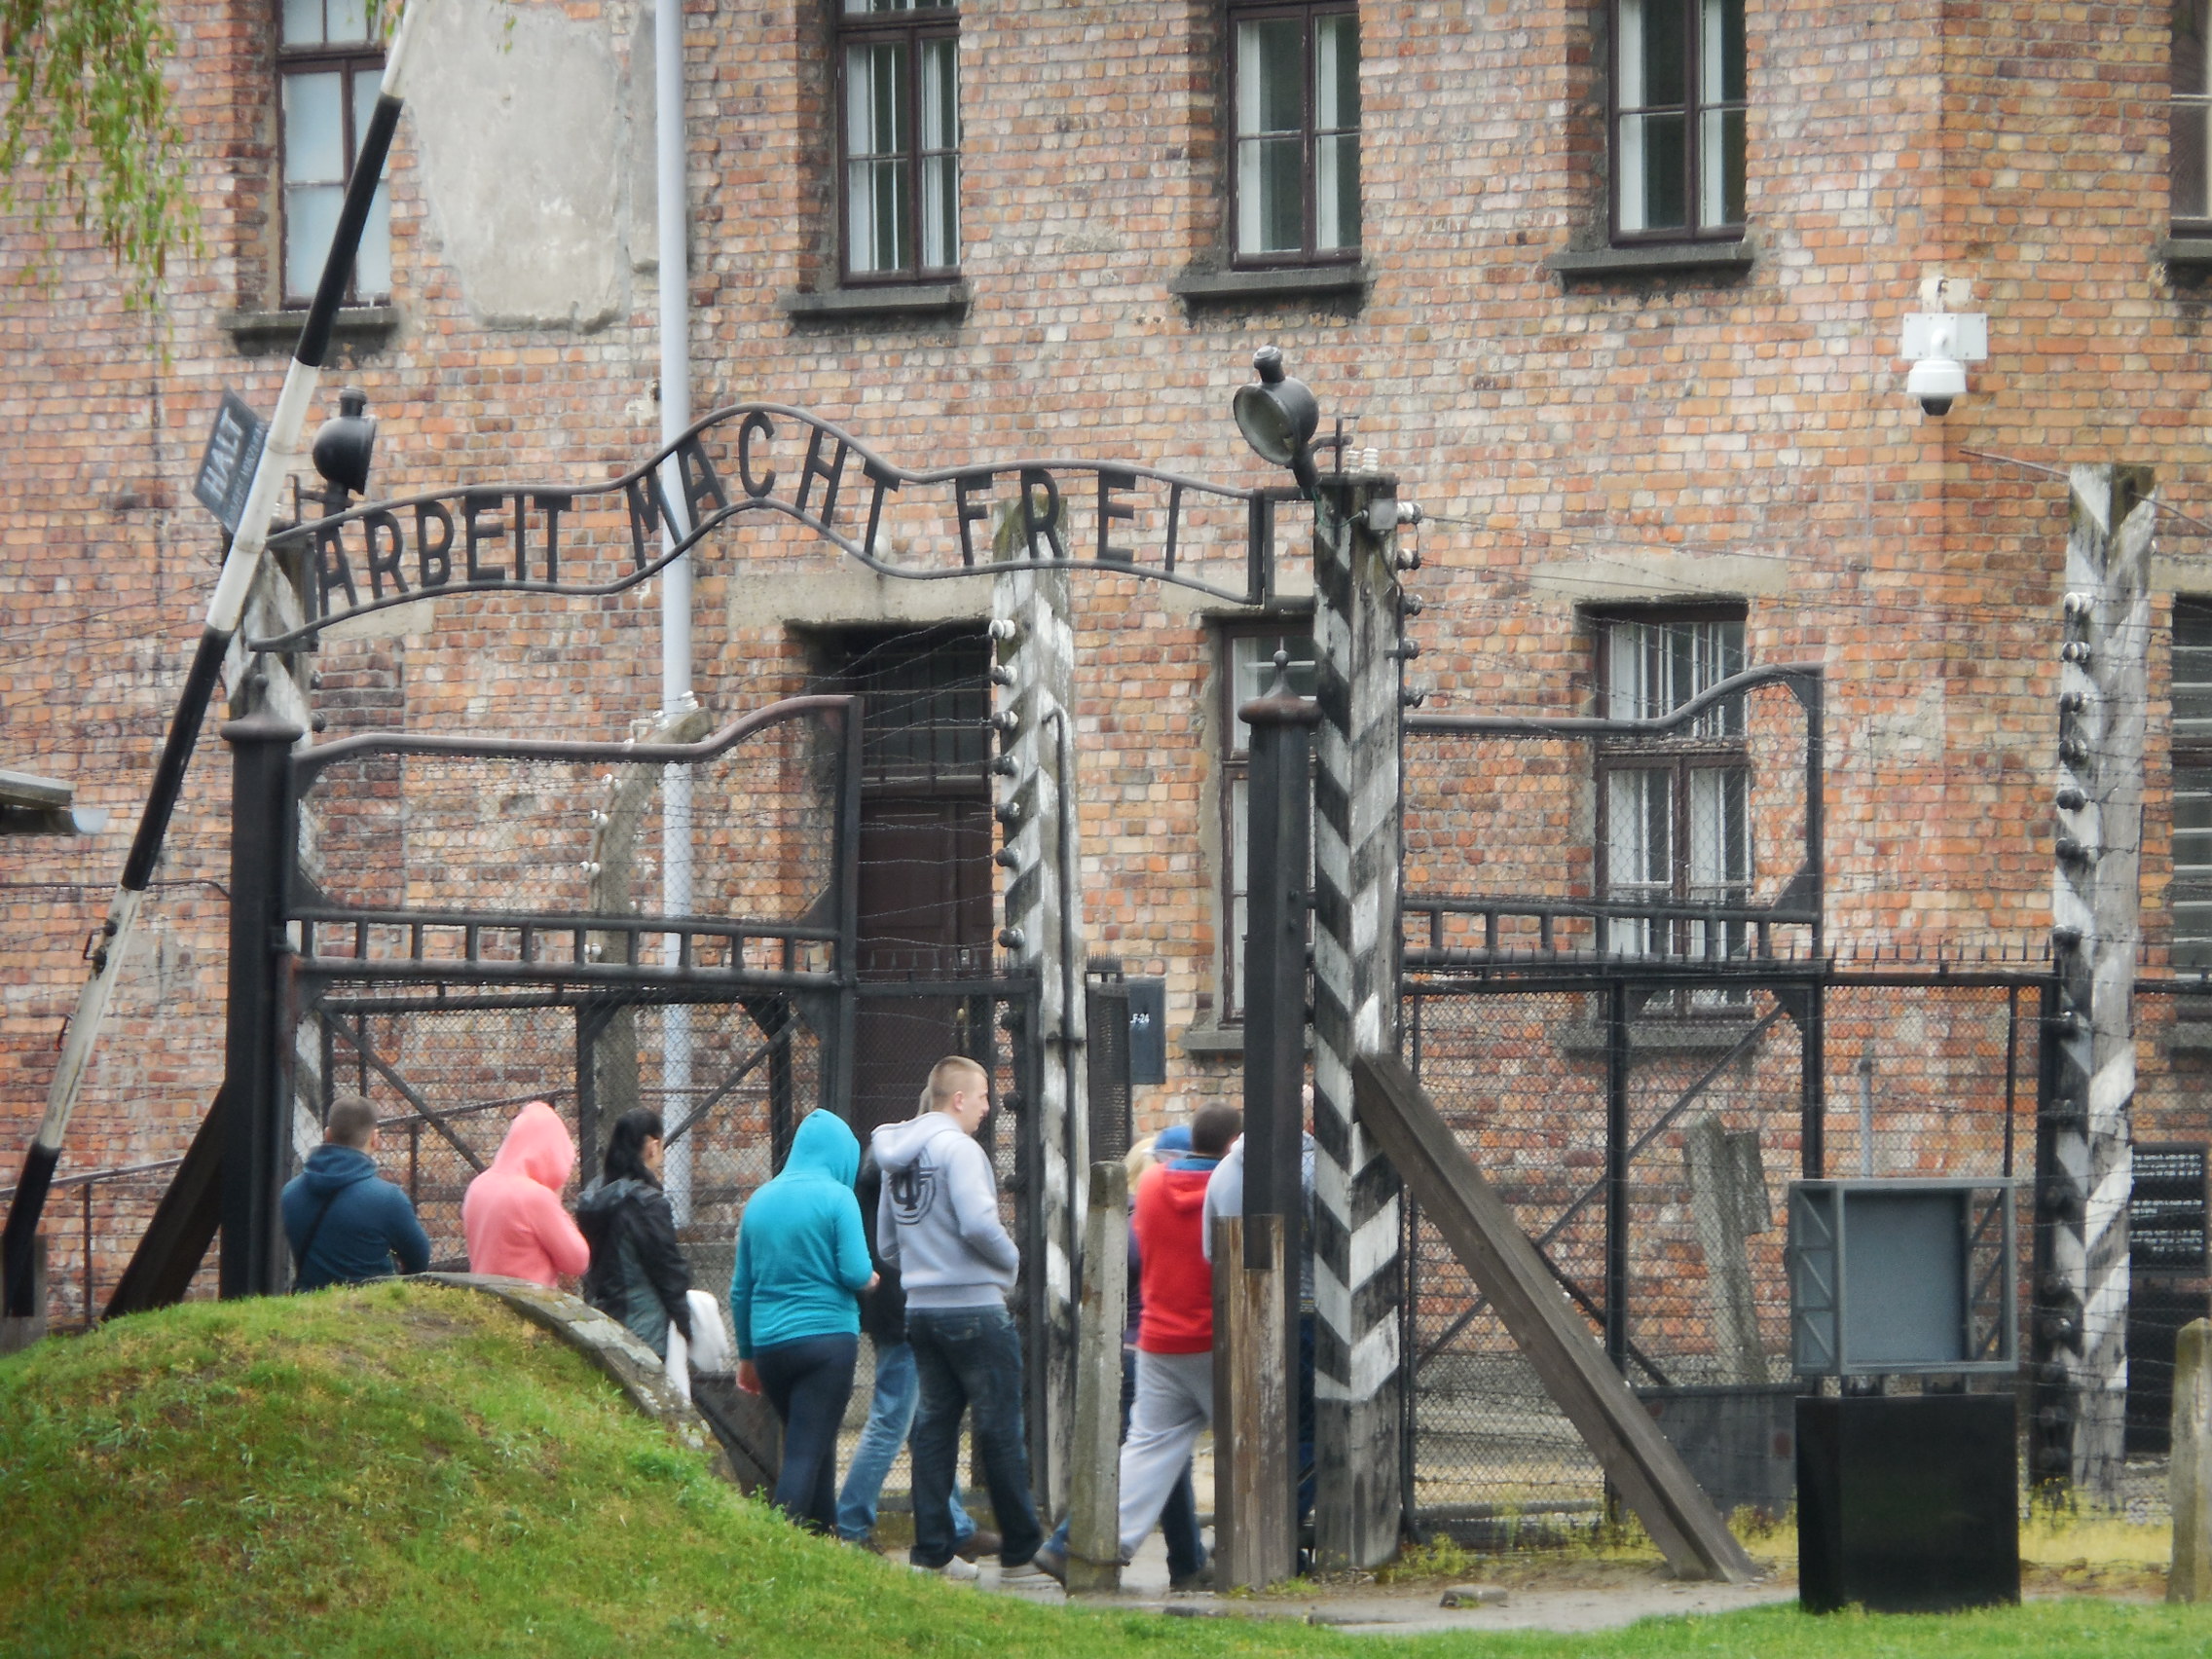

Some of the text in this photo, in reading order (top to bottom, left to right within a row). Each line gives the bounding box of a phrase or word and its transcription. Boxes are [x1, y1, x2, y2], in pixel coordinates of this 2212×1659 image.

[202, 406, 242, 501] HALT
[315, 411, 1182, 618] ARBEIT MACHT FREI
